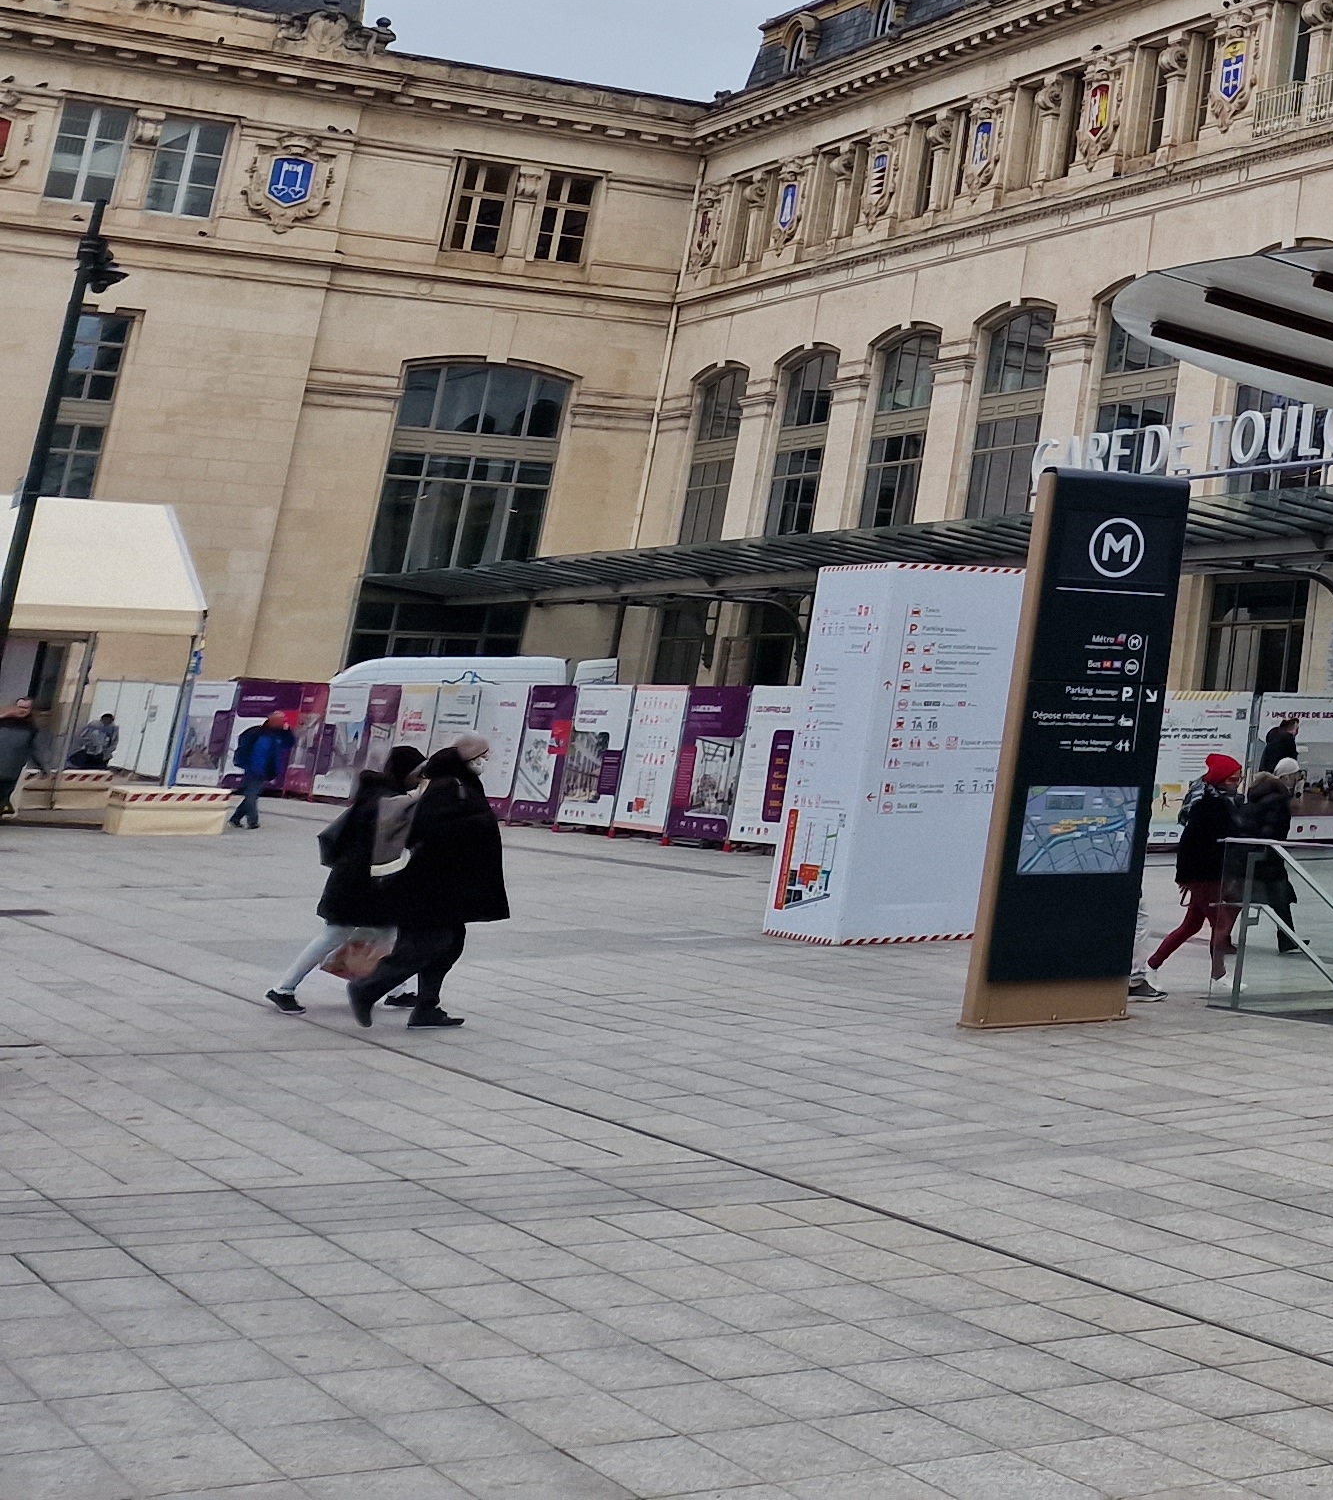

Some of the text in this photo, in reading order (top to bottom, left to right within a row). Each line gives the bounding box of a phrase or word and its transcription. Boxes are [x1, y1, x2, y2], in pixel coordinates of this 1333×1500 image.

[1140, 421, 1196, 475] DE
[1091, 634, 1116, 644] Métro
[1065, 685, 1094, 697] Parking
[1031, 710, 1062, 721] Dépose
[1062, 711, 1091, 720] minute
[1271, 711, 1287, 719] UNE
[1311, 711, 1321, 719] DE
[911, 720, 923, 729] 1A
